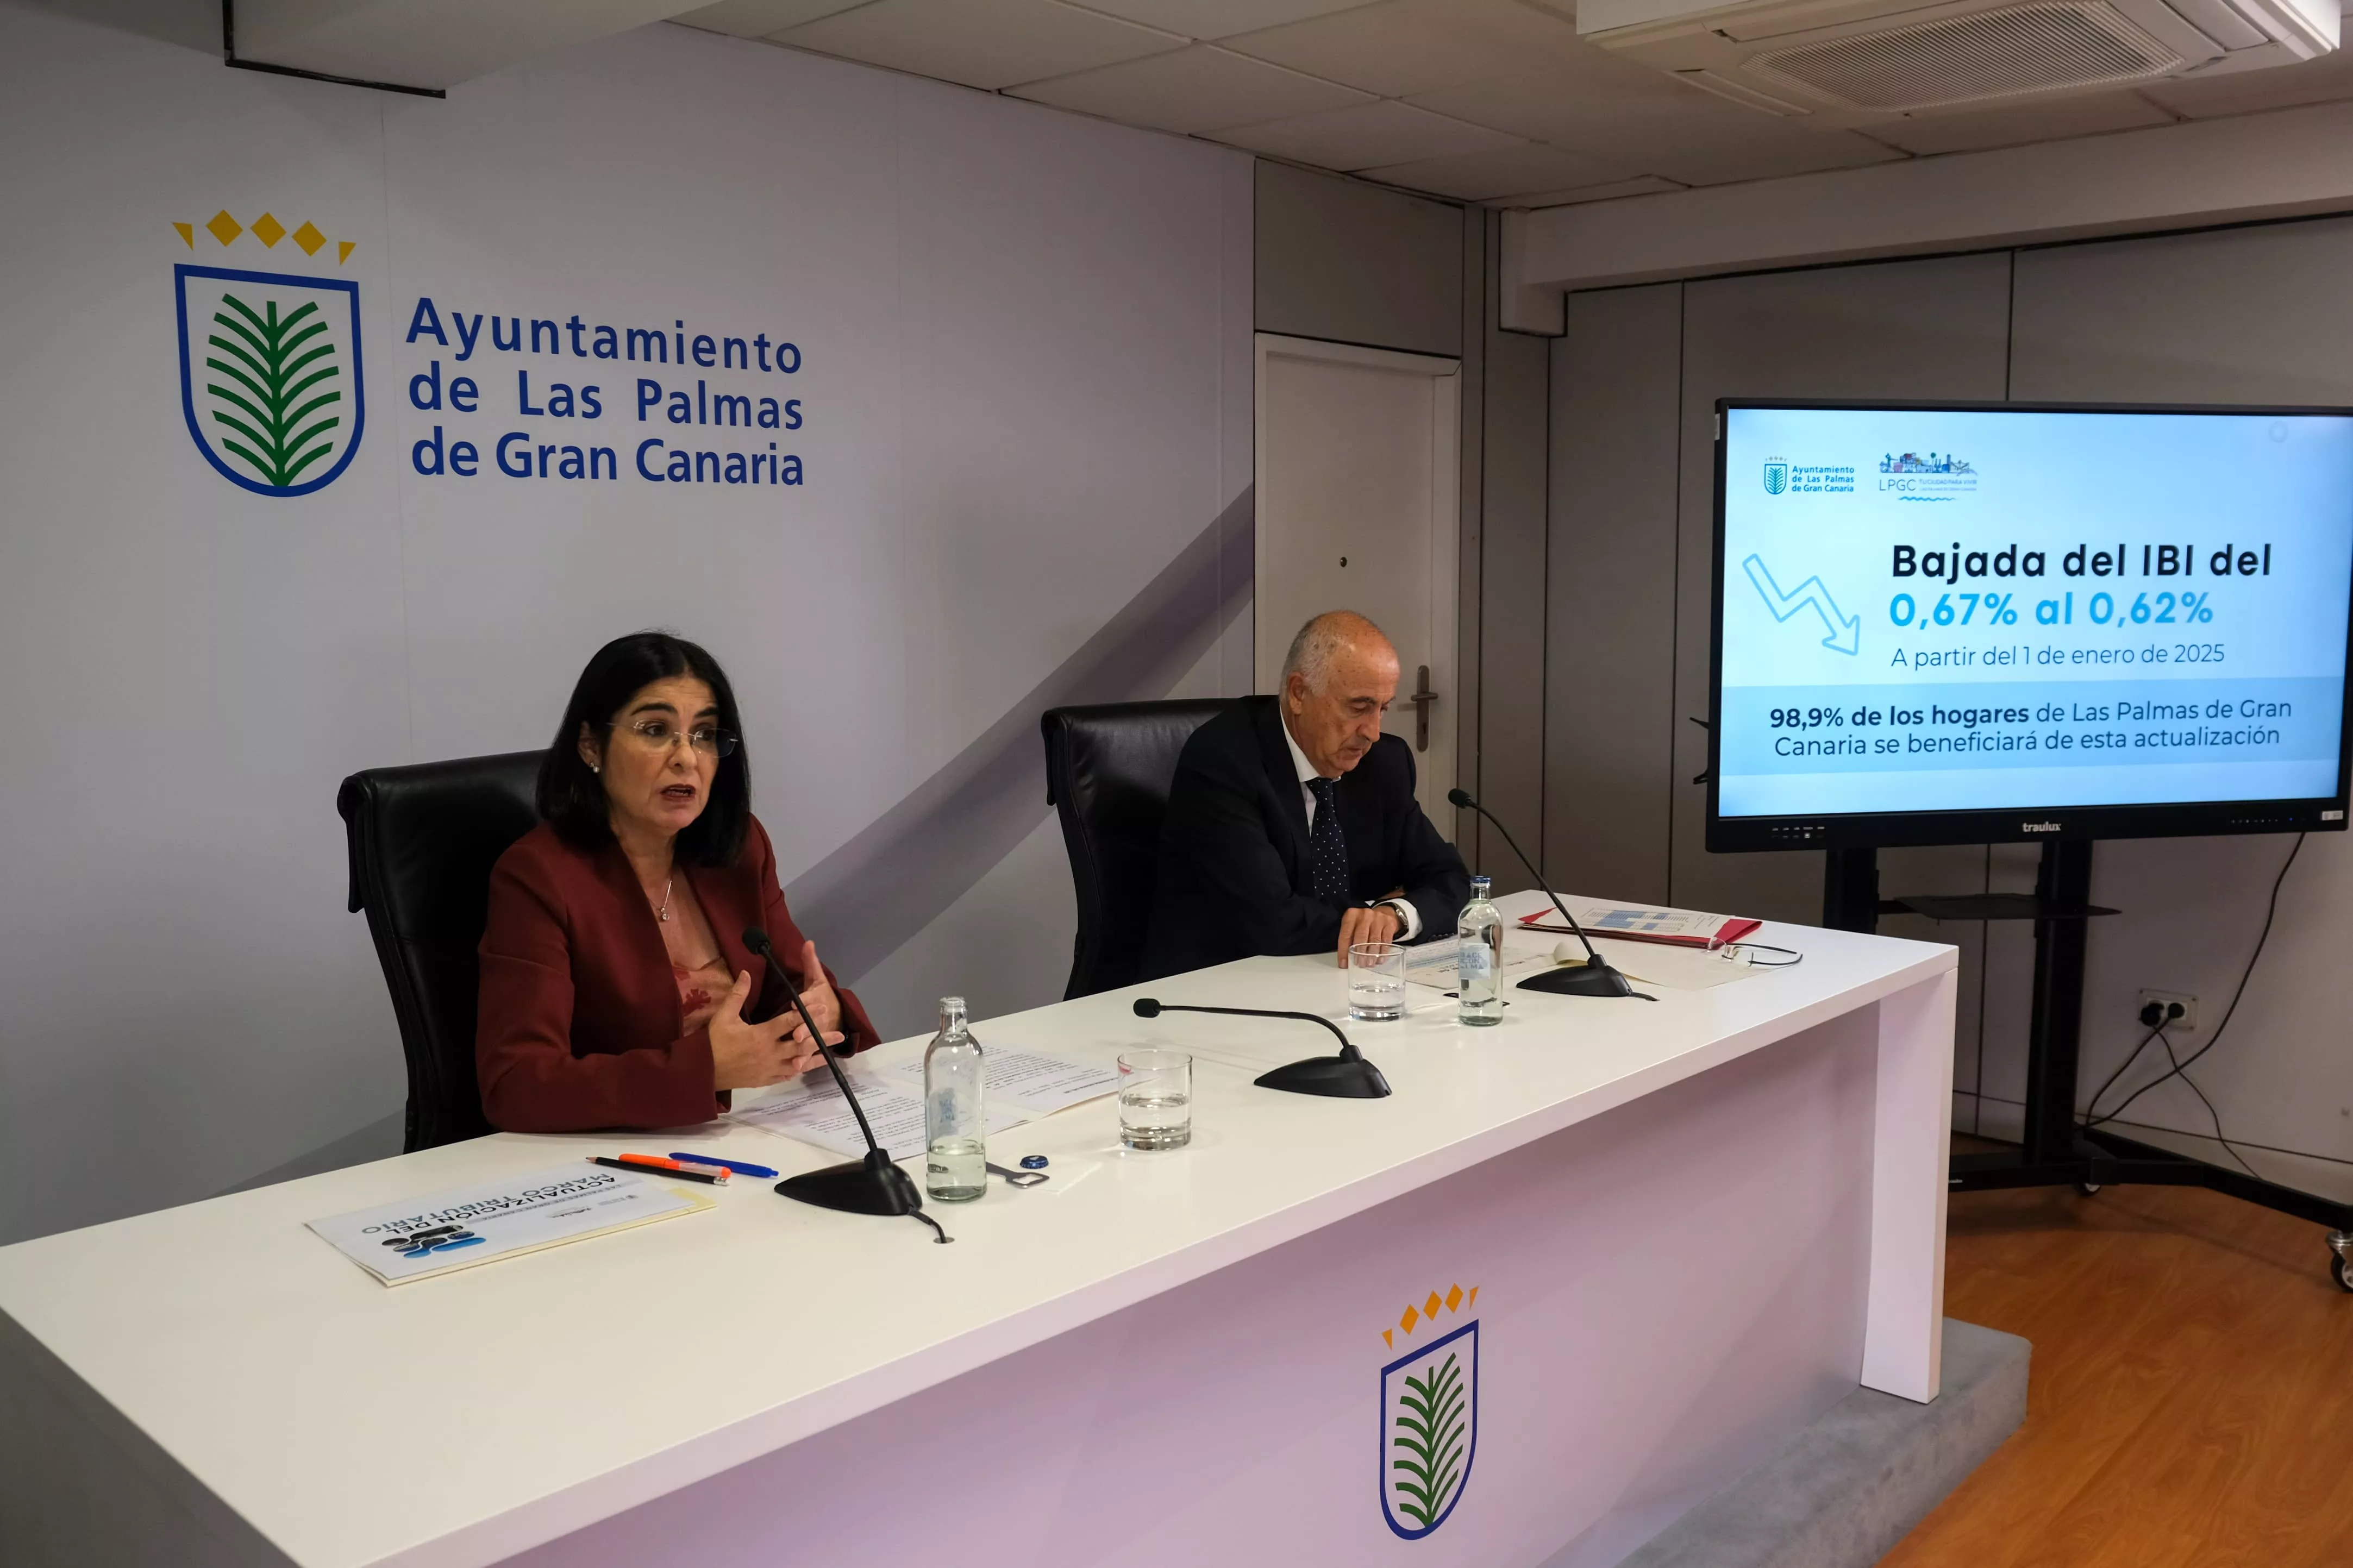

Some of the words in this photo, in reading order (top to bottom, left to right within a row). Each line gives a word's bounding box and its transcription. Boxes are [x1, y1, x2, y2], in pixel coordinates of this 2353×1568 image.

[406, 297, 802, 374] Ayuntamiento
[409, 360, 479, 412] de
[518, 370, 603, 419] Las
[637, 378, 803, 430] Palmas
[412, 425, 479, 476] de
[496, 431, 617, 480] Gran
[636, 438, 804, 485] Canaria
[1792, 466, 1855, 475] Ayuntamiento
[1792, 474, 1803, 482] de
[1879, 479, 1917, 492] LPGC
[1892, 542, 2046, 585] Bajada
[2063, 543, 2126, 576] del
[2143, 544, 2194, 576] IBI
[2210, 543, 2272, 576] del
[1889, 592, 2018, 630] 0,67%
[2035, 592, 2074, 625] al
[2089, 591, 2214, 628] 0,62%
[1891, 648, 1908, 667] A
[1915, 647, 1976, 671] partir
[1982, 645, 2017, 666] del
[2023, 646, 2030, 665] 1
[2037, 645, 2066, 664] de
[2072, 649, 2135, 664] enero
[2141, 643, 2168, 663] de
[2174, 643, 2225, 663] 2025
[1769, 707, 1844, 732] 98,9%
[1851, 706, 1882, 726] de
[1890, 705, 1924, 726] los
[1932, 705, 2030, 729] hogares
[2036, 703, 2065, 723] de
[2073, 703, 2110, 722] Las
[2117, 700, 2199, 720] Palmas
[2205, 699, 2233, 719] de
[2240, 699, 2292, 718] Gran
[1774, 734, 1867, 757] Canaria
[1874, 738, 1900, 754] se
[1908, 731, 2038, 754] beneficiará
[2045, 730, 2074, 749] de
[2080, 731, 2127, 749] esta
[2133, 725, 2281, 748] actualización
[2023, 821, 2062, 832] traulux
[437, 1176, 616, 1225] ACTUALIZACIÓN
[522, 1173, 609, 1196] MARCO
[361, 1195, 517, 1234] TRIBUTARIO
[386, 1221, 432, 1234] DEL
